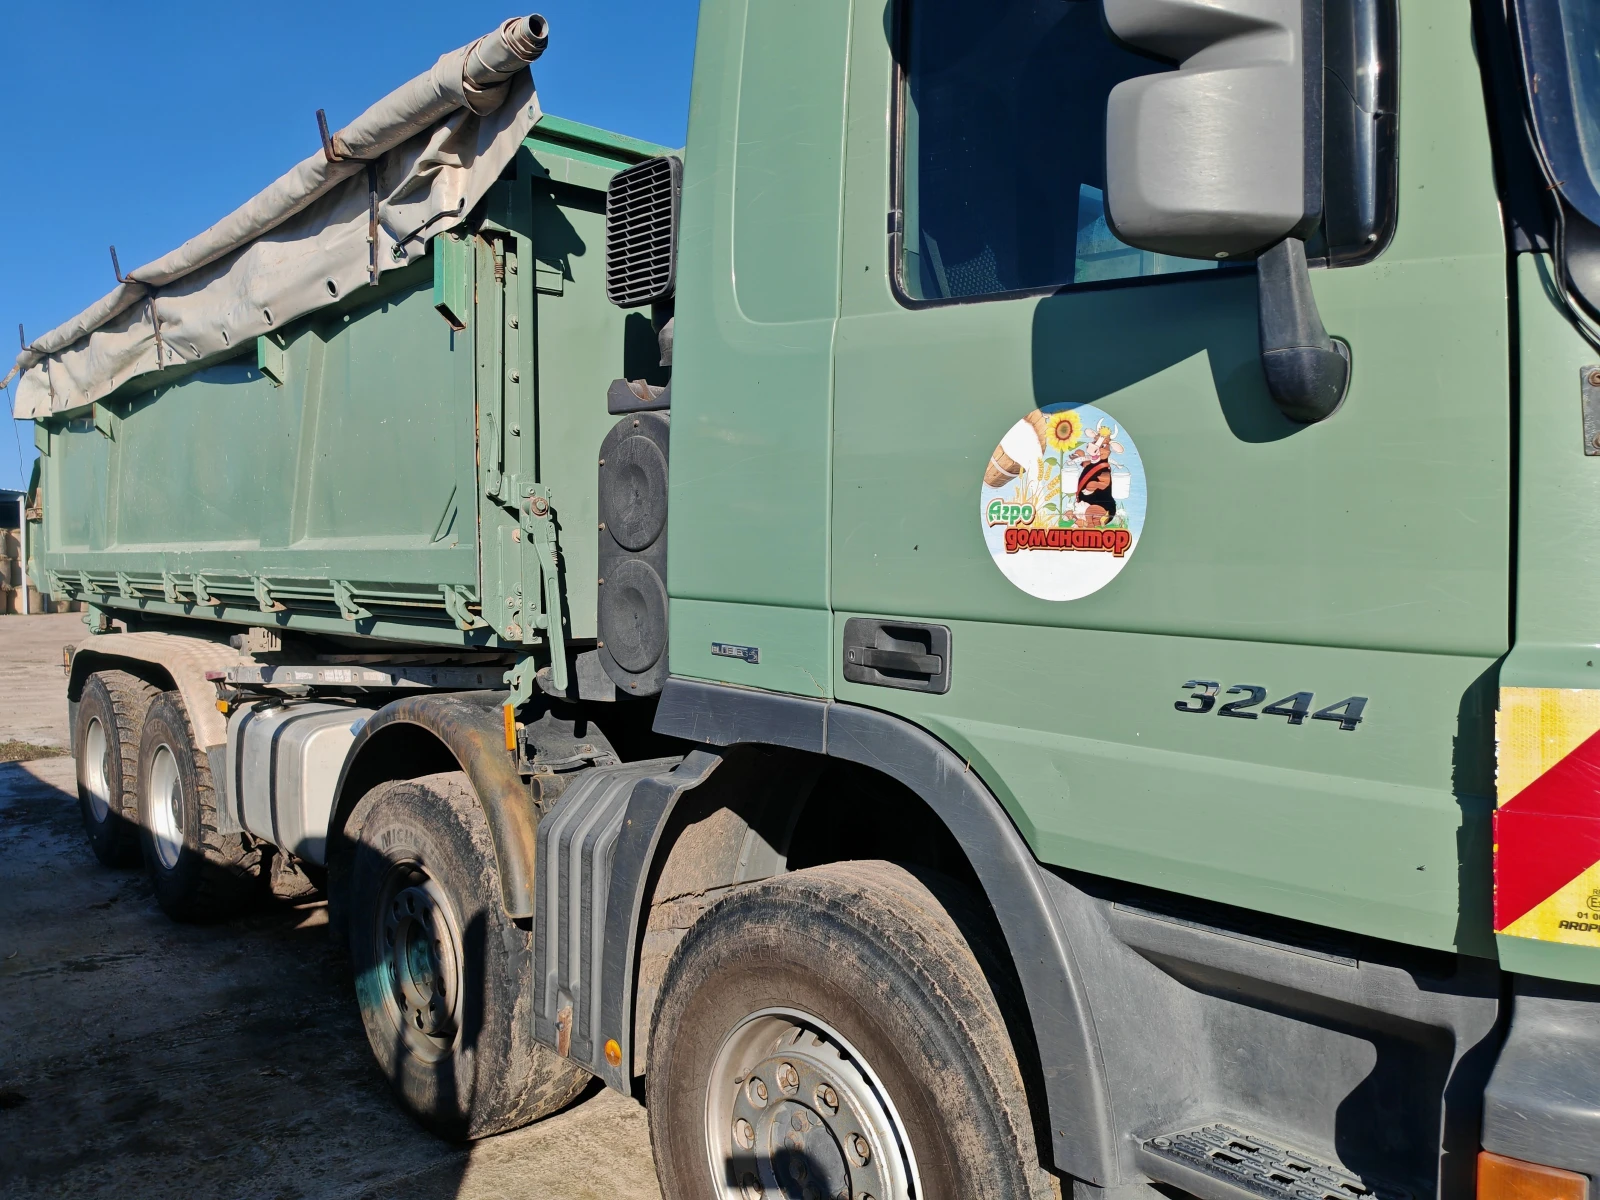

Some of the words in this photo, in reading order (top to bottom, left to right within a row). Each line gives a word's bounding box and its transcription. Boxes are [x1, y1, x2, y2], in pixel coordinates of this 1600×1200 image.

[987, 499, 1034, 526] Агро
[1174, 679, 1369, 731] 3244
[1558, 920, 1600, 932] AROP
